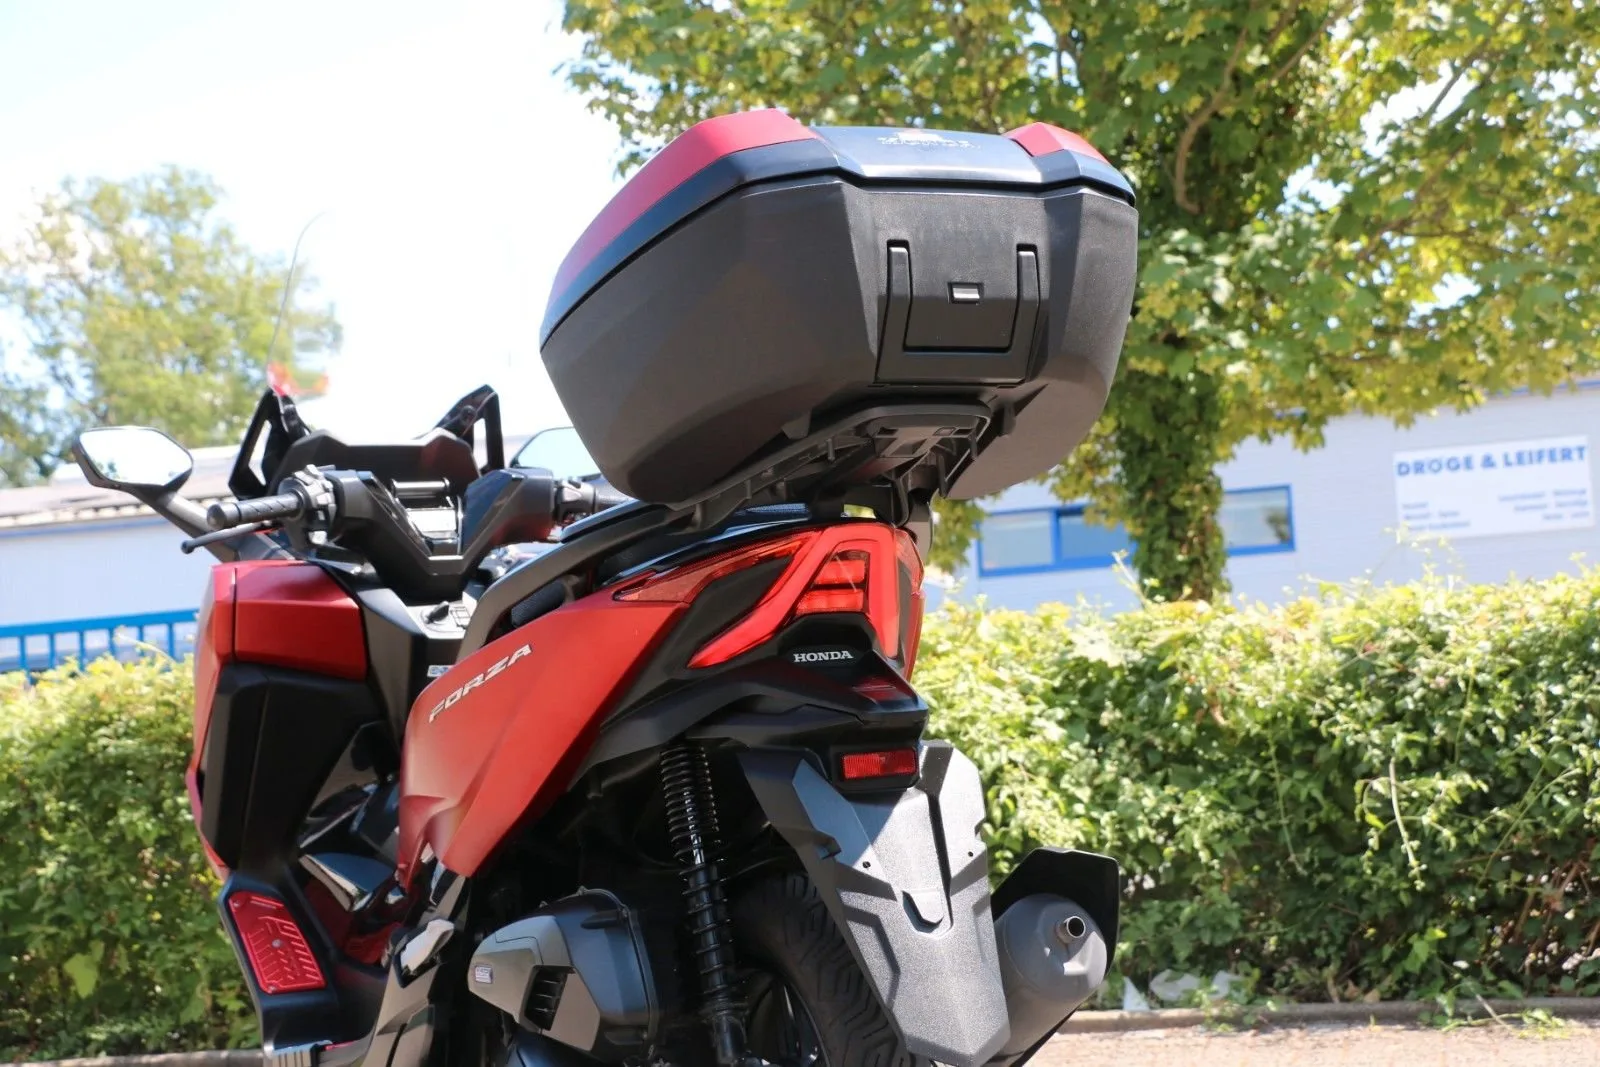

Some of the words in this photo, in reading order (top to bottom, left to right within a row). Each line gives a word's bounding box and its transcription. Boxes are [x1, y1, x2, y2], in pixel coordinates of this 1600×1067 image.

[1481, 453, 1496, 468] &
[1502, 446, 1587, 467] LEIFERT
[793, 650, 854, 663] HONDA
[429, 644, 532, 723] FORZA
